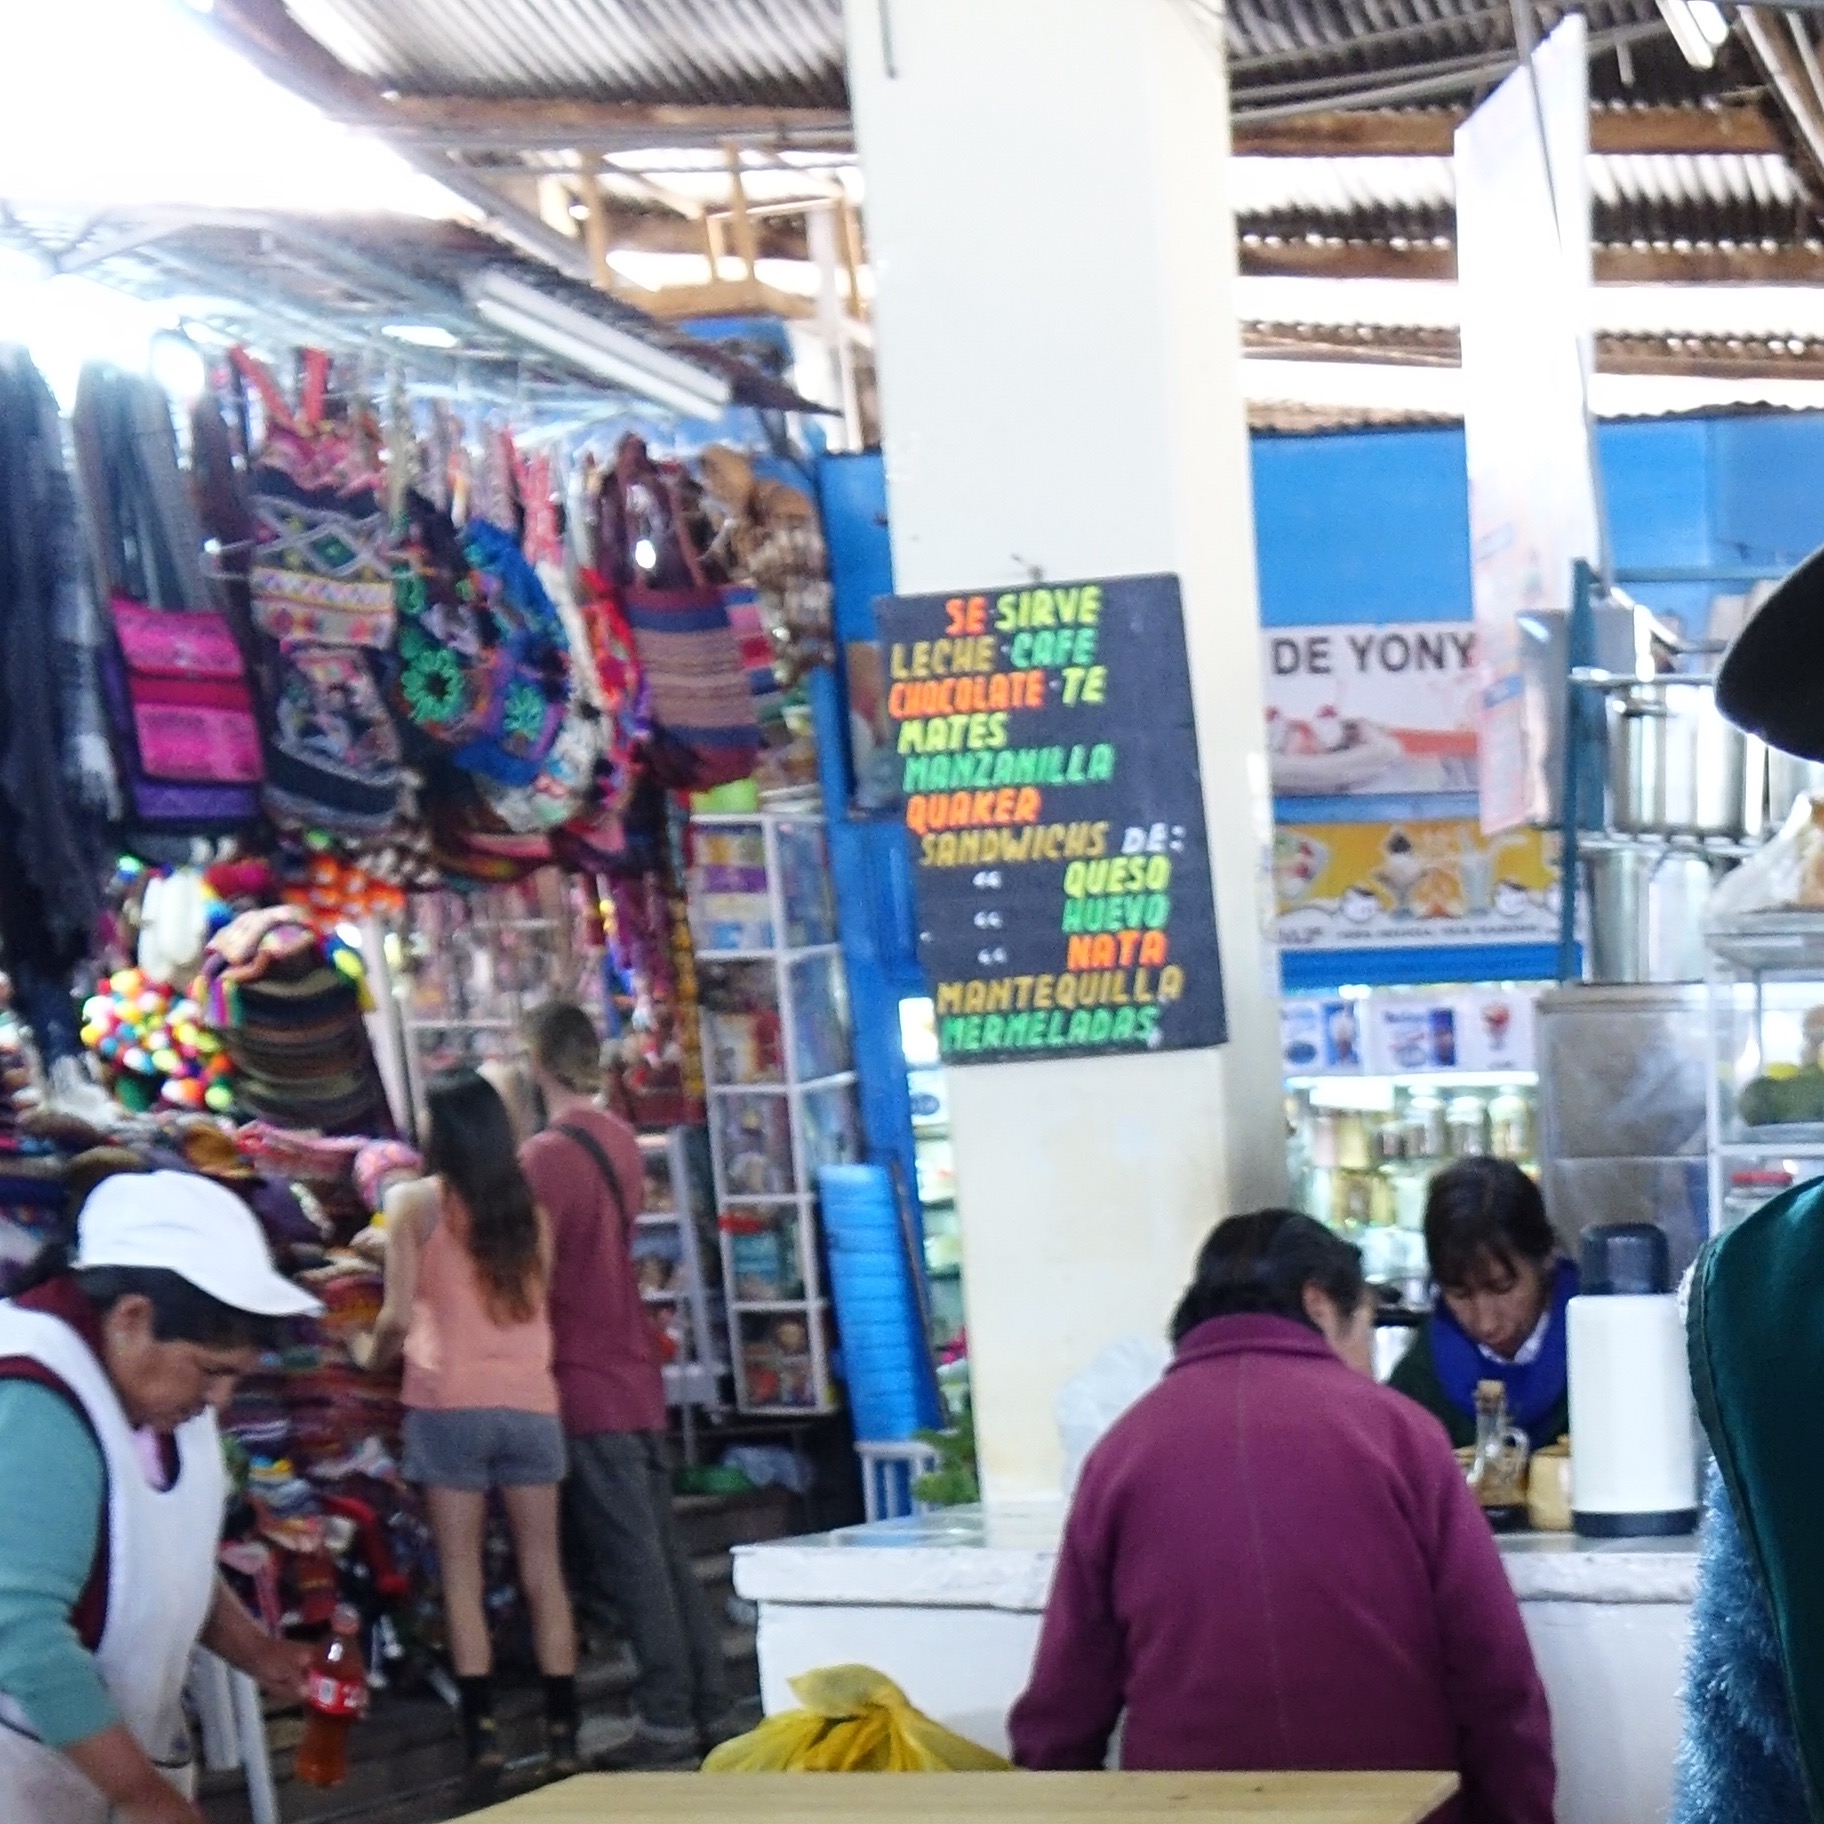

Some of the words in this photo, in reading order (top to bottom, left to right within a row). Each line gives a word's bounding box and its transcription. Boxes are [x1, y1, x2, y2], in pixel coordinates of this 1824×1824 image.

[945, 595, 988, 636] SE
[994, 585, 1102, 632] SIRVE
[890, 635, 996, 680] LECHE
[1010, 628, 1098, 669] CAFE
[1273, 636, 1331, 675] DE
[1348, 631, 1476, 673] YONY
[888, 669, 1046, 719] CHOCOLATE
[1061, 665, 1108, 707] TE
[897, 711, 1010, 754] MATES
[903, 743, 1116, 793] MANZANILLA
[905, 786, 1042, 835] QUAKER
[918, 820, 1110, 867] SANDWICHS
[1063, 855, 1172, 899] QUESO
[1061, 893, 1171, 933] HUEVO
[1067, 930, 1168, 972] NATA
[936, 965, 1185, 1015] MANTEQUILLA
[940, 1004, 1160, 1052] MERMELADAS
